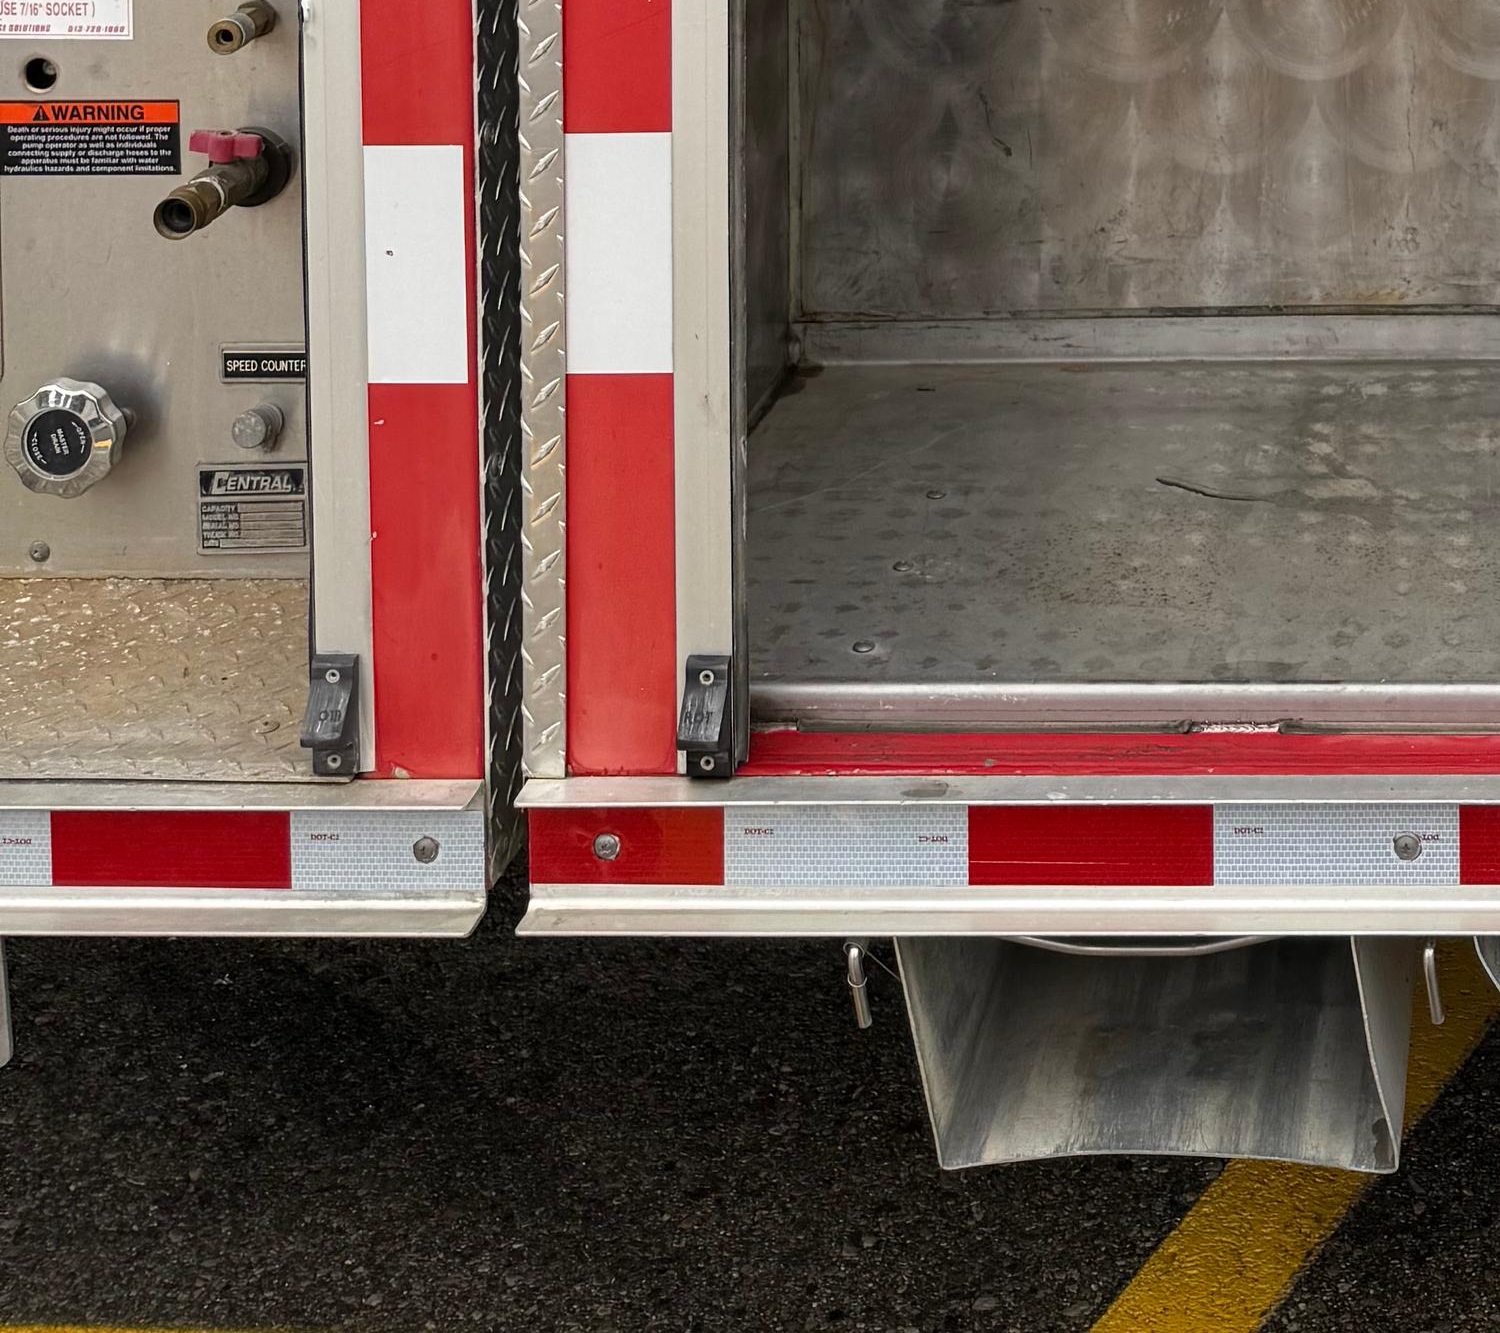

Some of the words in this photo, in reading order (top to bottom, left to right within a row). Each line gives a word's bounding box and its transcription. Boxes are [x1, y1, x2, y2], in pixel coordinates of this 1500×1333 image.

[45, 2, 89, 16] SOCKET
[51, 105, 145, 121] WARNING
[7, 125, 30, 133] Death
[70, 126, 92, 134] injury
[93, 125, 115, 134] might
[146, 126, 171, 134] proper
[10, 134, 46, 142] operating
[47, 134, 90, 142] procedures
[154, 133, 169, 141] The
[45, 142, 77, 150] operator
[7, 150, 50, 158] connecting
[51, 150, 77, 158] supply
[88, 149, 124, 157] discharge
[4, 165, 43, 174] hydraulics
[91, 165, 134, 173] component
[226, 360, 258, 372] SPEED
[57, 428, 70, 455] MASTER
[76, 427, 86, 445] OPEN
[32, 438, 43, 460] CLOSE
[51, 433, 61, 454] DRAIN
[211, 472, 292, 494] CENTRAL
